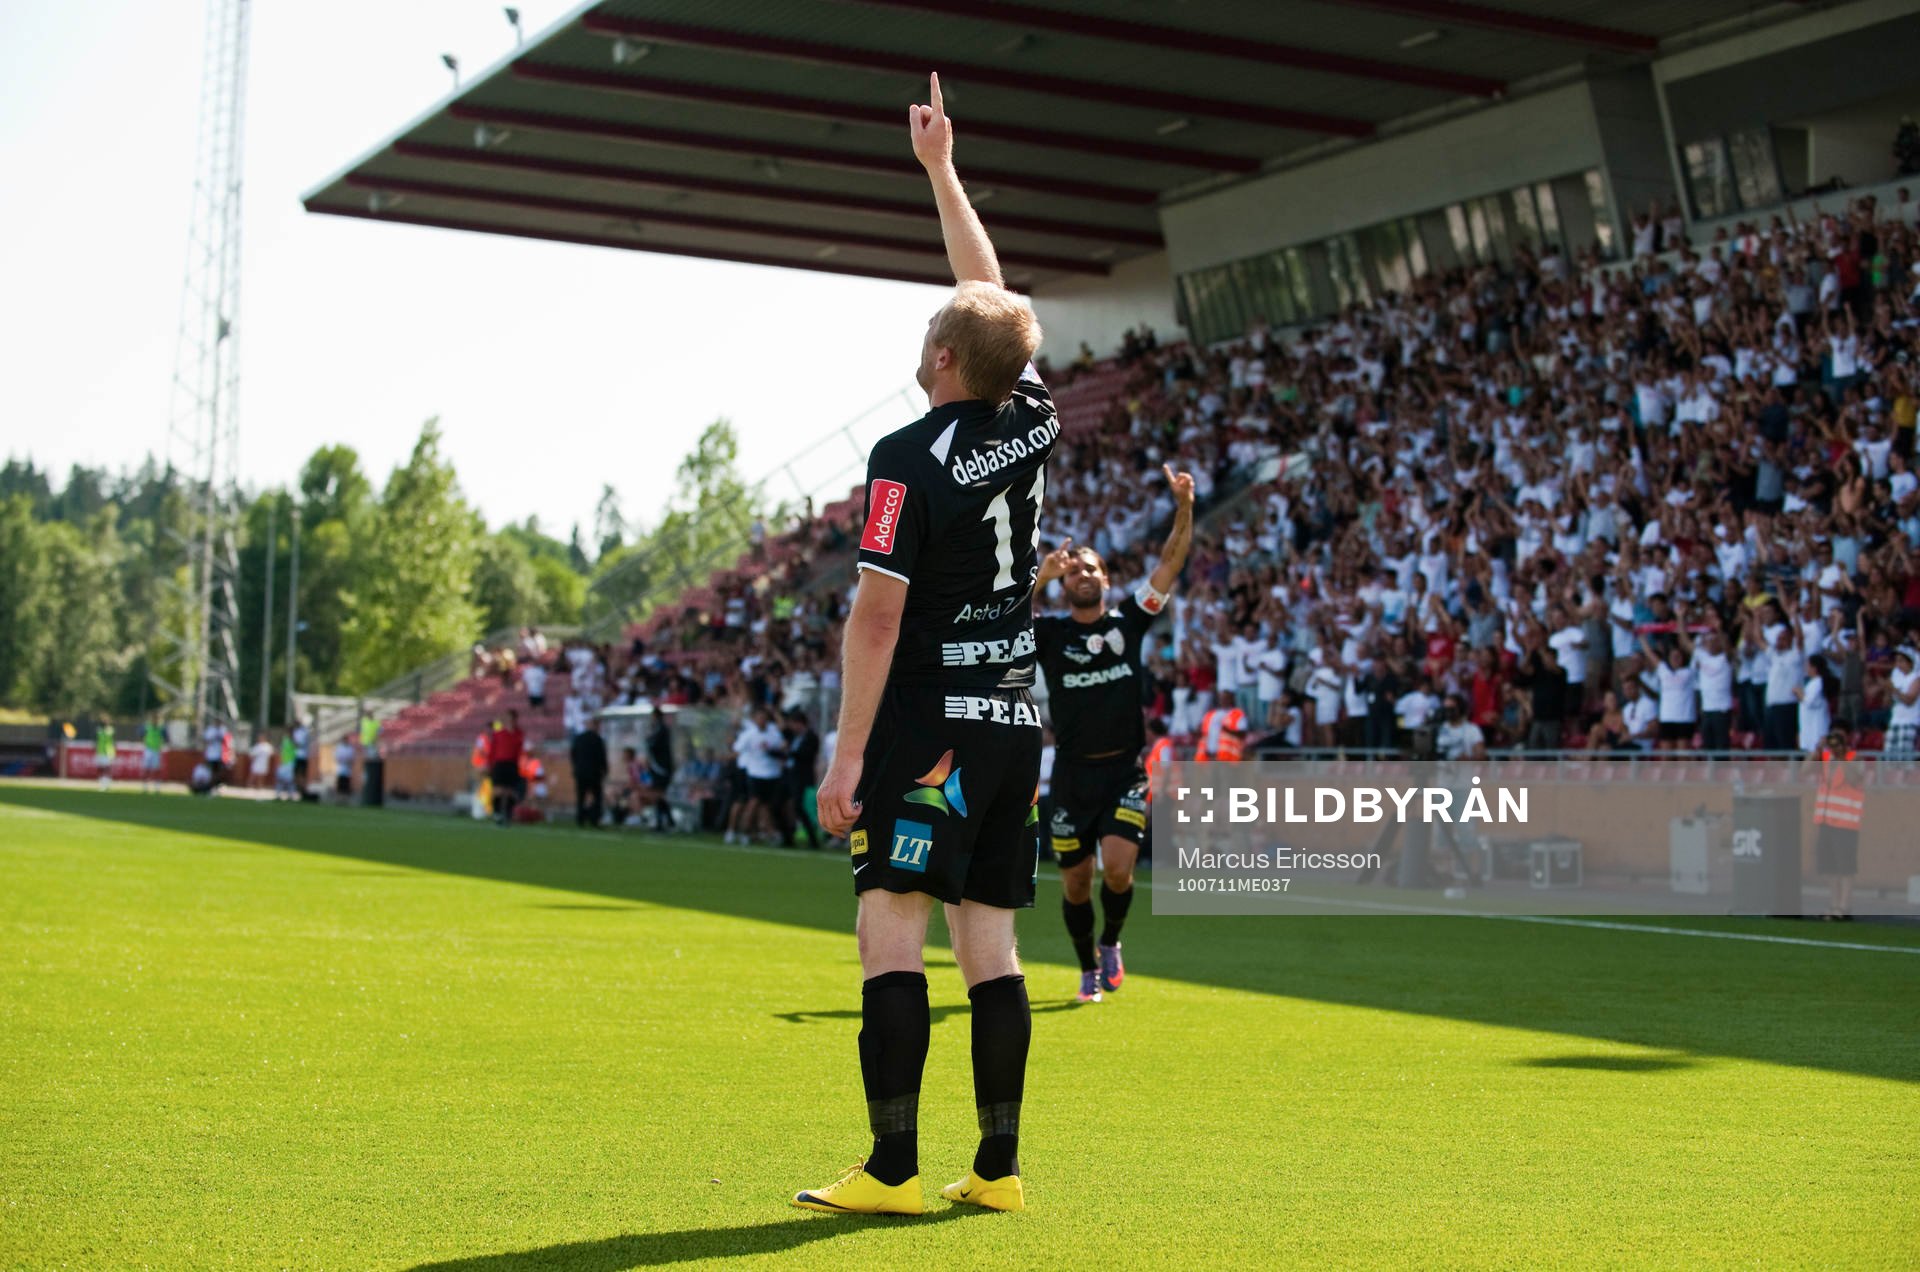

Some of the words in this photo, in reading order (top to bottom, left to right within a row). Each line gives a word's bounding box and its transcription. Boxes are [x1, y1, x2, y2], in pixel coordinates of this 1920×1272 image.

[874, 488, 900, 548] Adecco
[982, 463, 1045, 592] 11
[1062, 662, 1133, 688] SCANIA
[889, 834, 933, 865] LT
